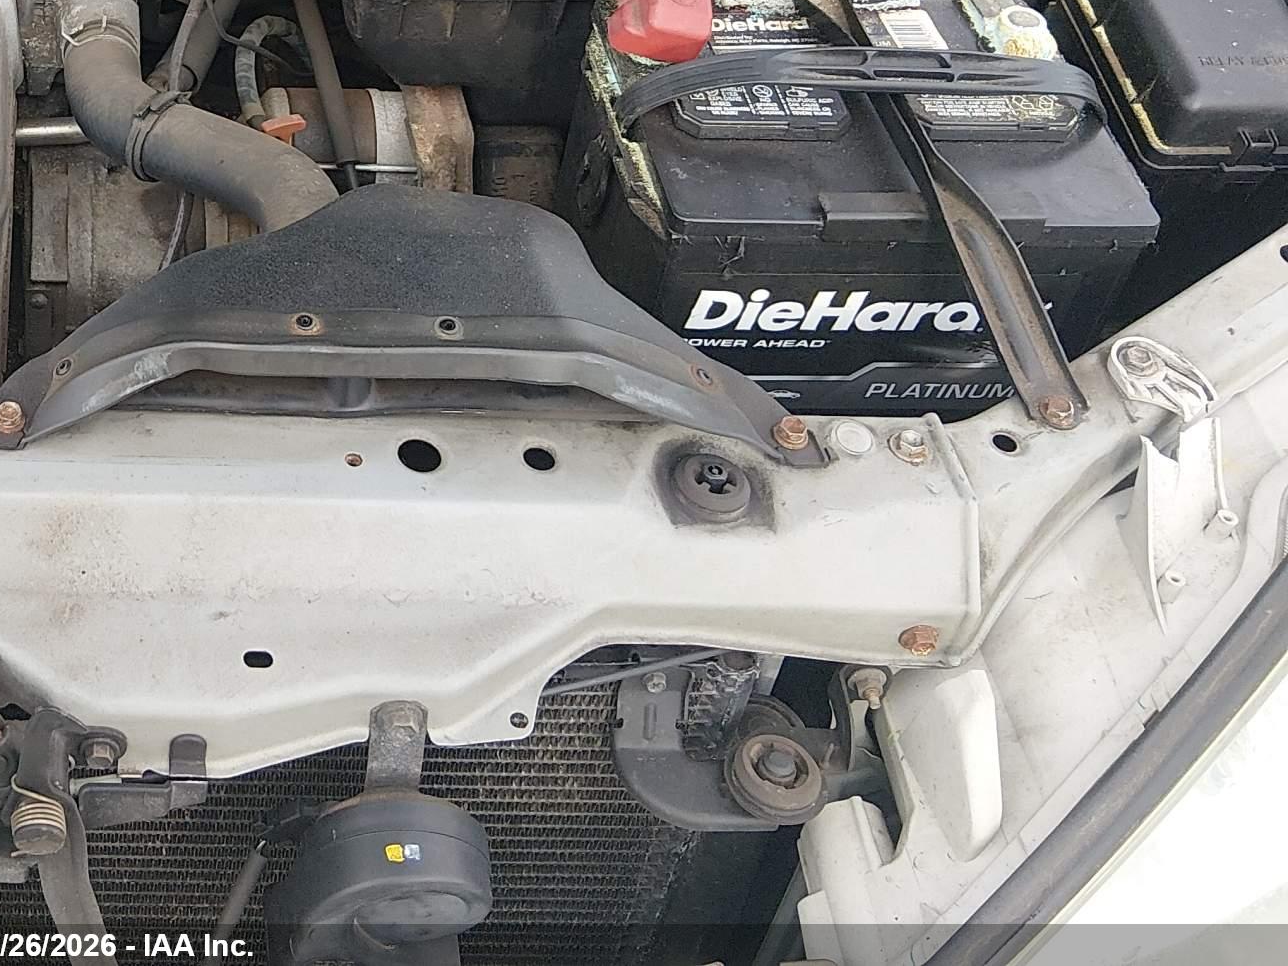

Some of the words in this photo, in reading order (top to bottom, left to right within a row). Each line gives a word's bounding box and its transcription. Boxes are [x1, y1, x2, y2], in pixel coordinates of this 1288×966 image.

[684, 338, 748, 349] OWER
[752, 339, 826, 349] AHEAD
[864, 383, 1014, 399] PLATINUM
